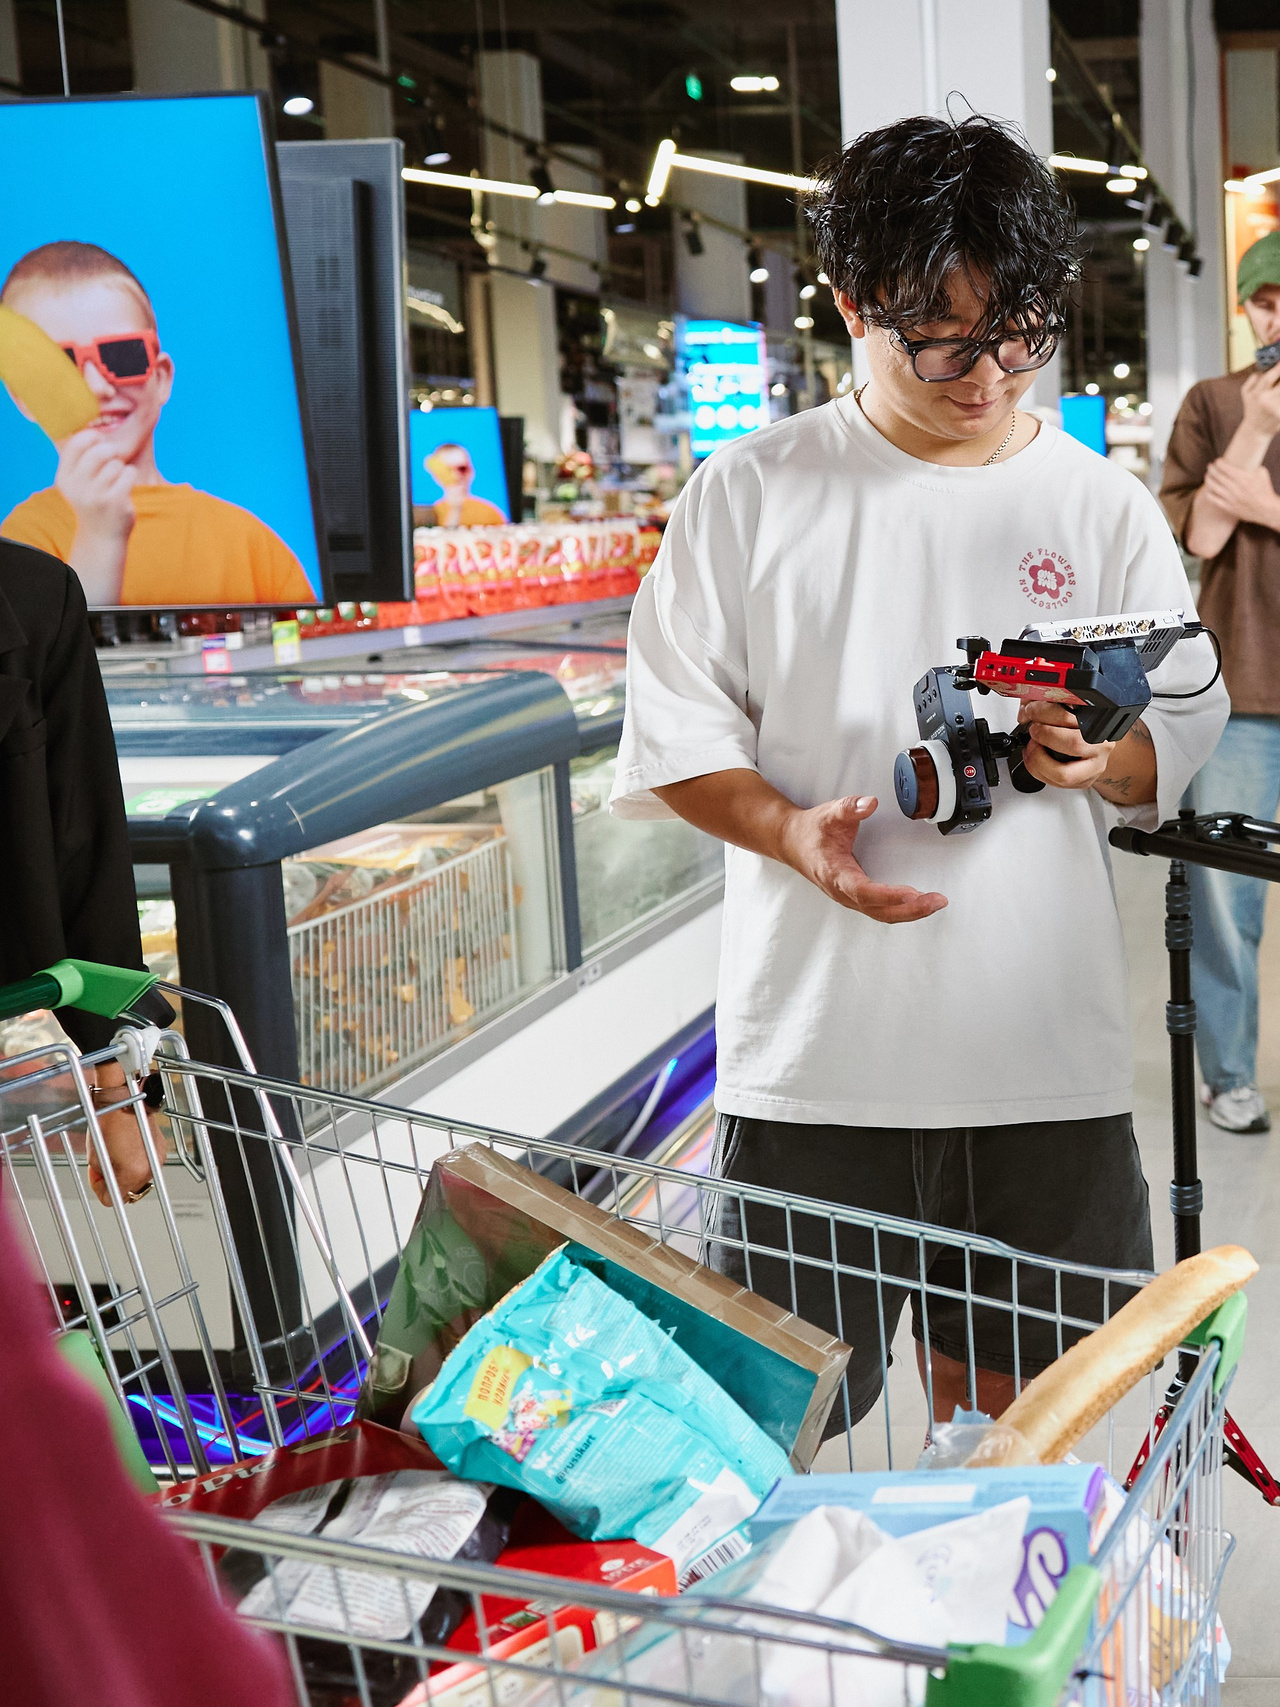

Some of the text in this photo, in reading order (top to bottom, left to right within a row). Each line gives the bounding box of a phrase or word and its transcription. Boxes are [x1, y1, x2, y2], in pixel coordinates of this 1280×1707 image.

[1018, 548, 1076, 610] THE FLOWERS COLLECTION
[198, 1459, 278, 1496] Pie
